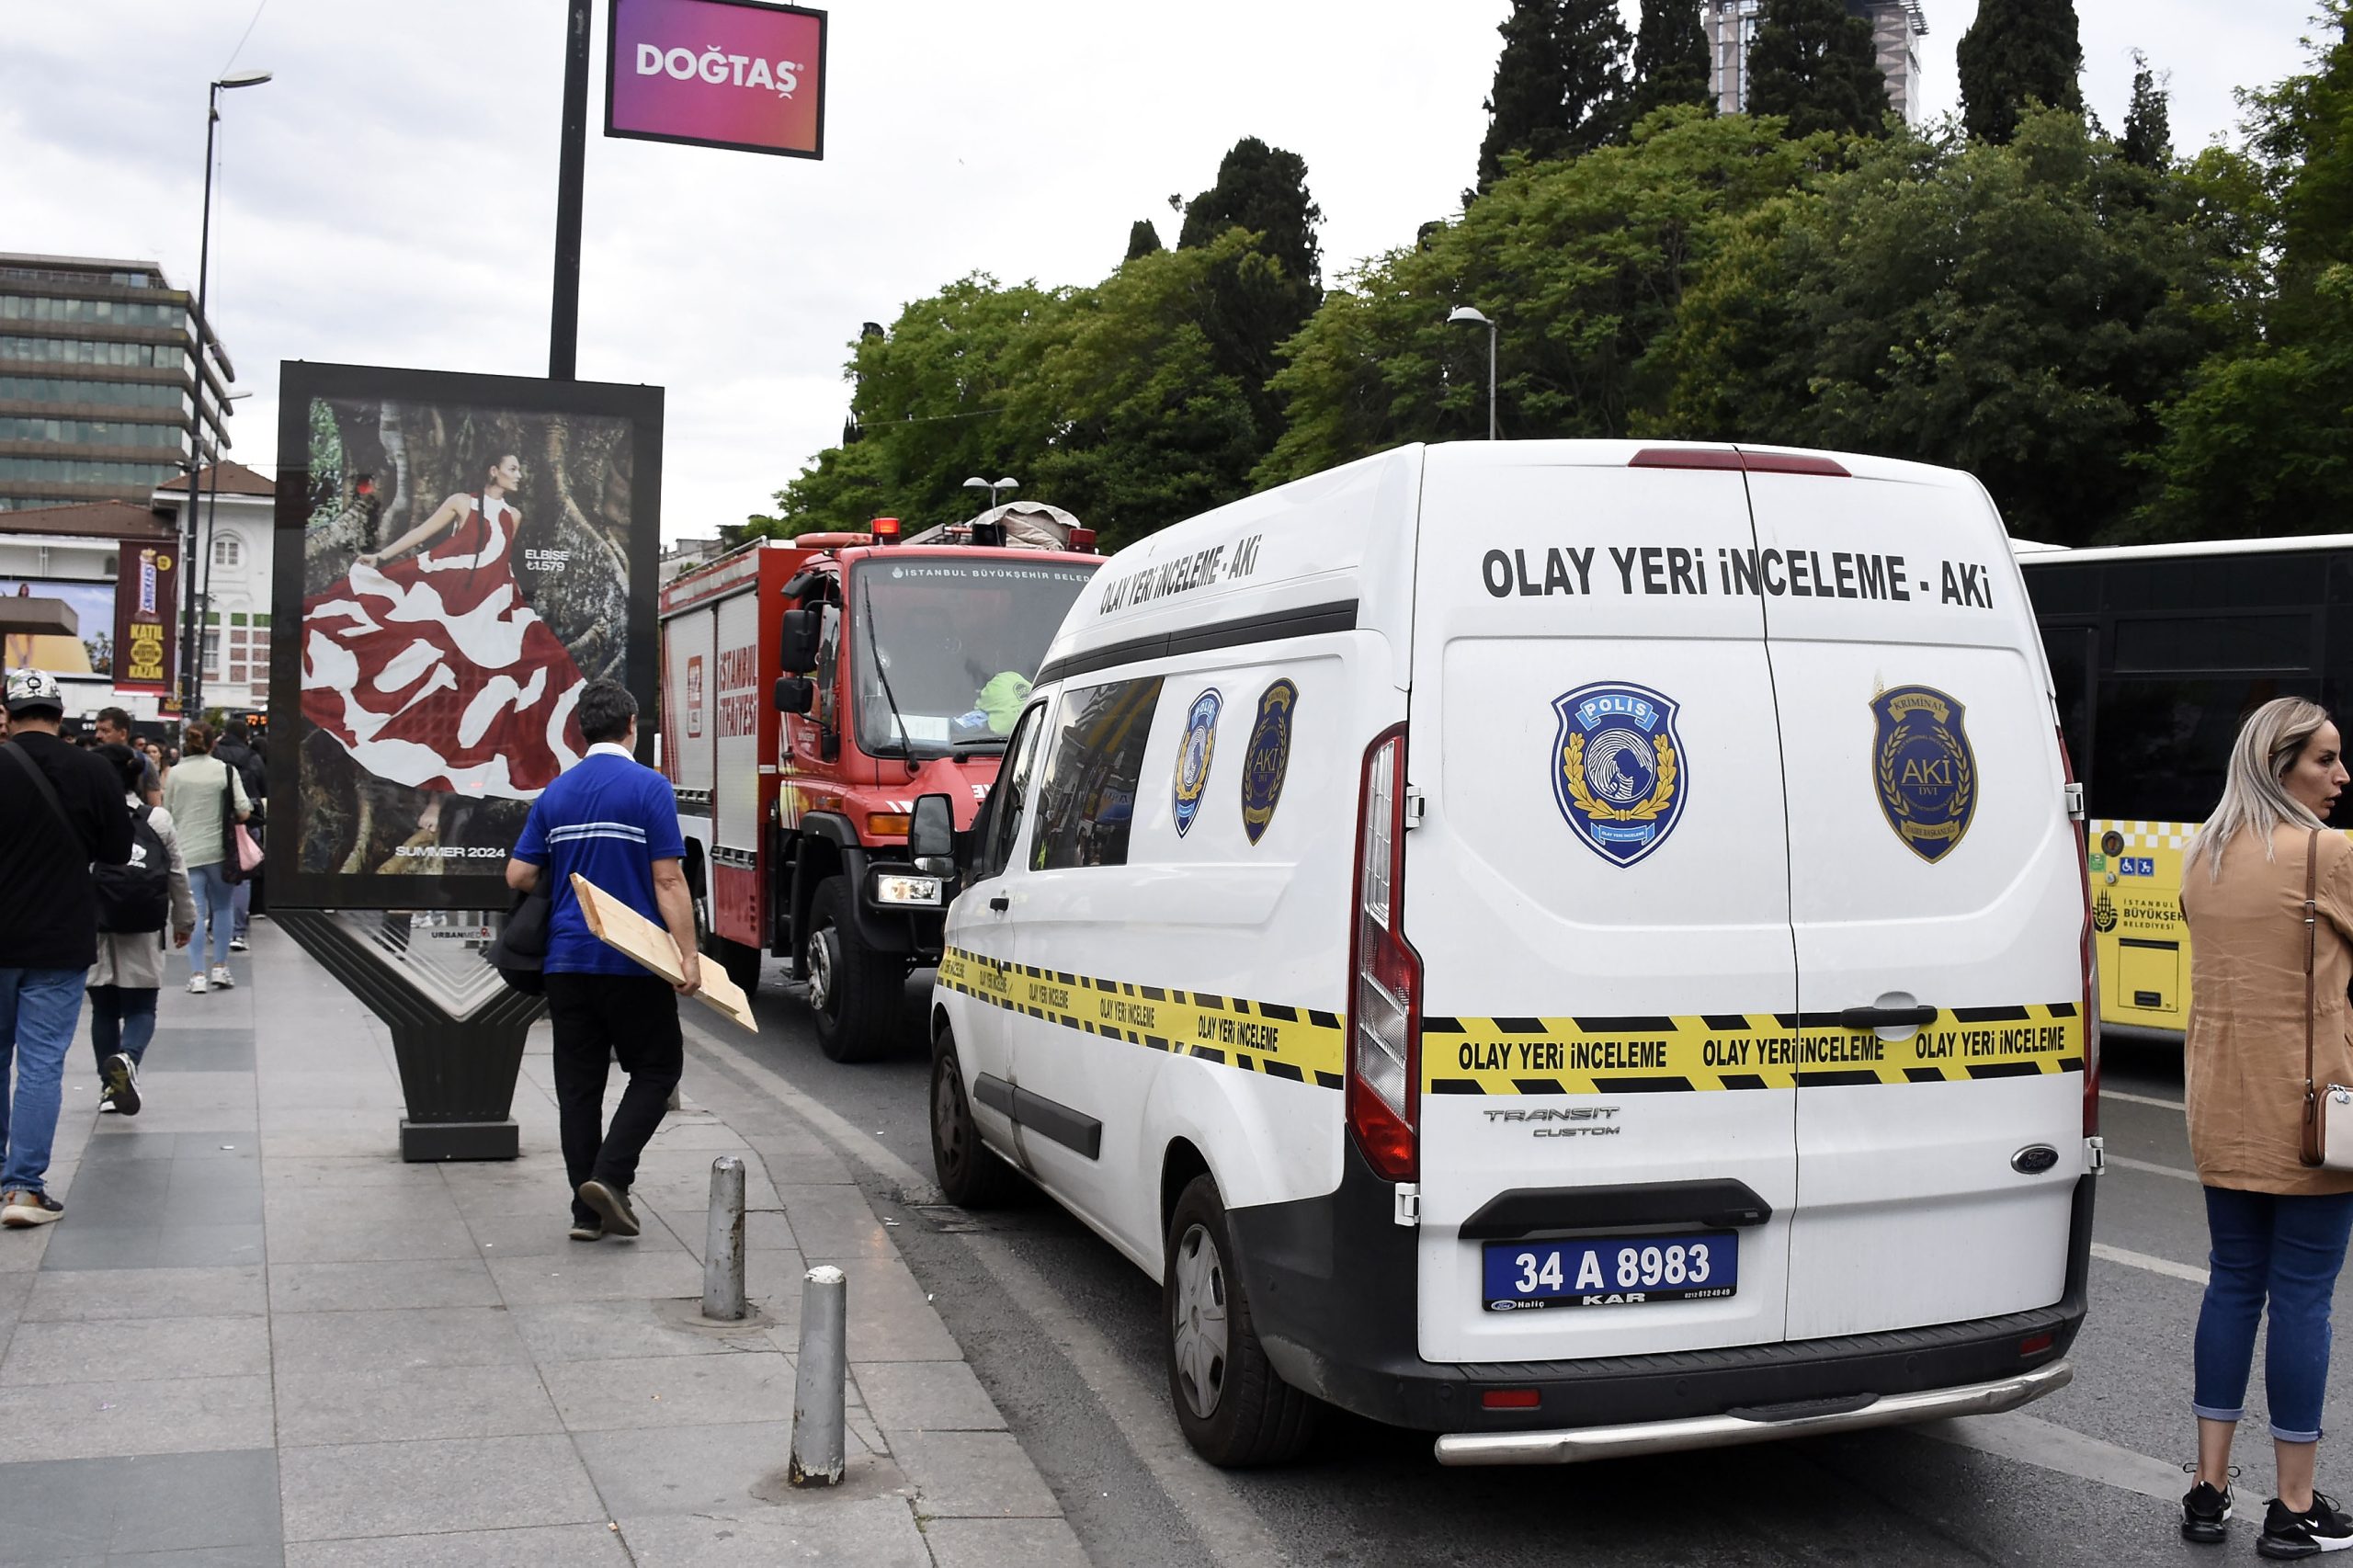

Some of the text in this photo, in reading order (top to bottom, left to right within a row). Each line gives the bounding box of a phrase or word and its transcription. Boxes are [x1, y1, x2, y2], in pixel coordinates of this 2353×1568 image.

[636, 43, 798, 99] DOĞTAŞ
[1054, 572, 1091, 583] BELED
[1482, 547, 1595, 597] OLAY
[1099, 575, 1131, 615] OLAY
[395, 846, 506, 858] SUMMER 2024
[1099, 998, 1113, 1019] OLAY
[1198, 1015, 1217, 1040] OLAY
[1459, 1042, 1513, 1070] OLAY
[1702, 1039, 1751, 1066] OLAY
[1915, 1032, 1958, 1059] OLAY
[1483, 1106, 1620, 1123] TRANSIT
[1532, 1126, 1620, 1138] CUSTOM
[1515, 1244, 1711, 1293] 34 A 8983
[1518, 1300, 1545, 1309] Haliç
[1582, 1292, 1645, 1306] KAR
